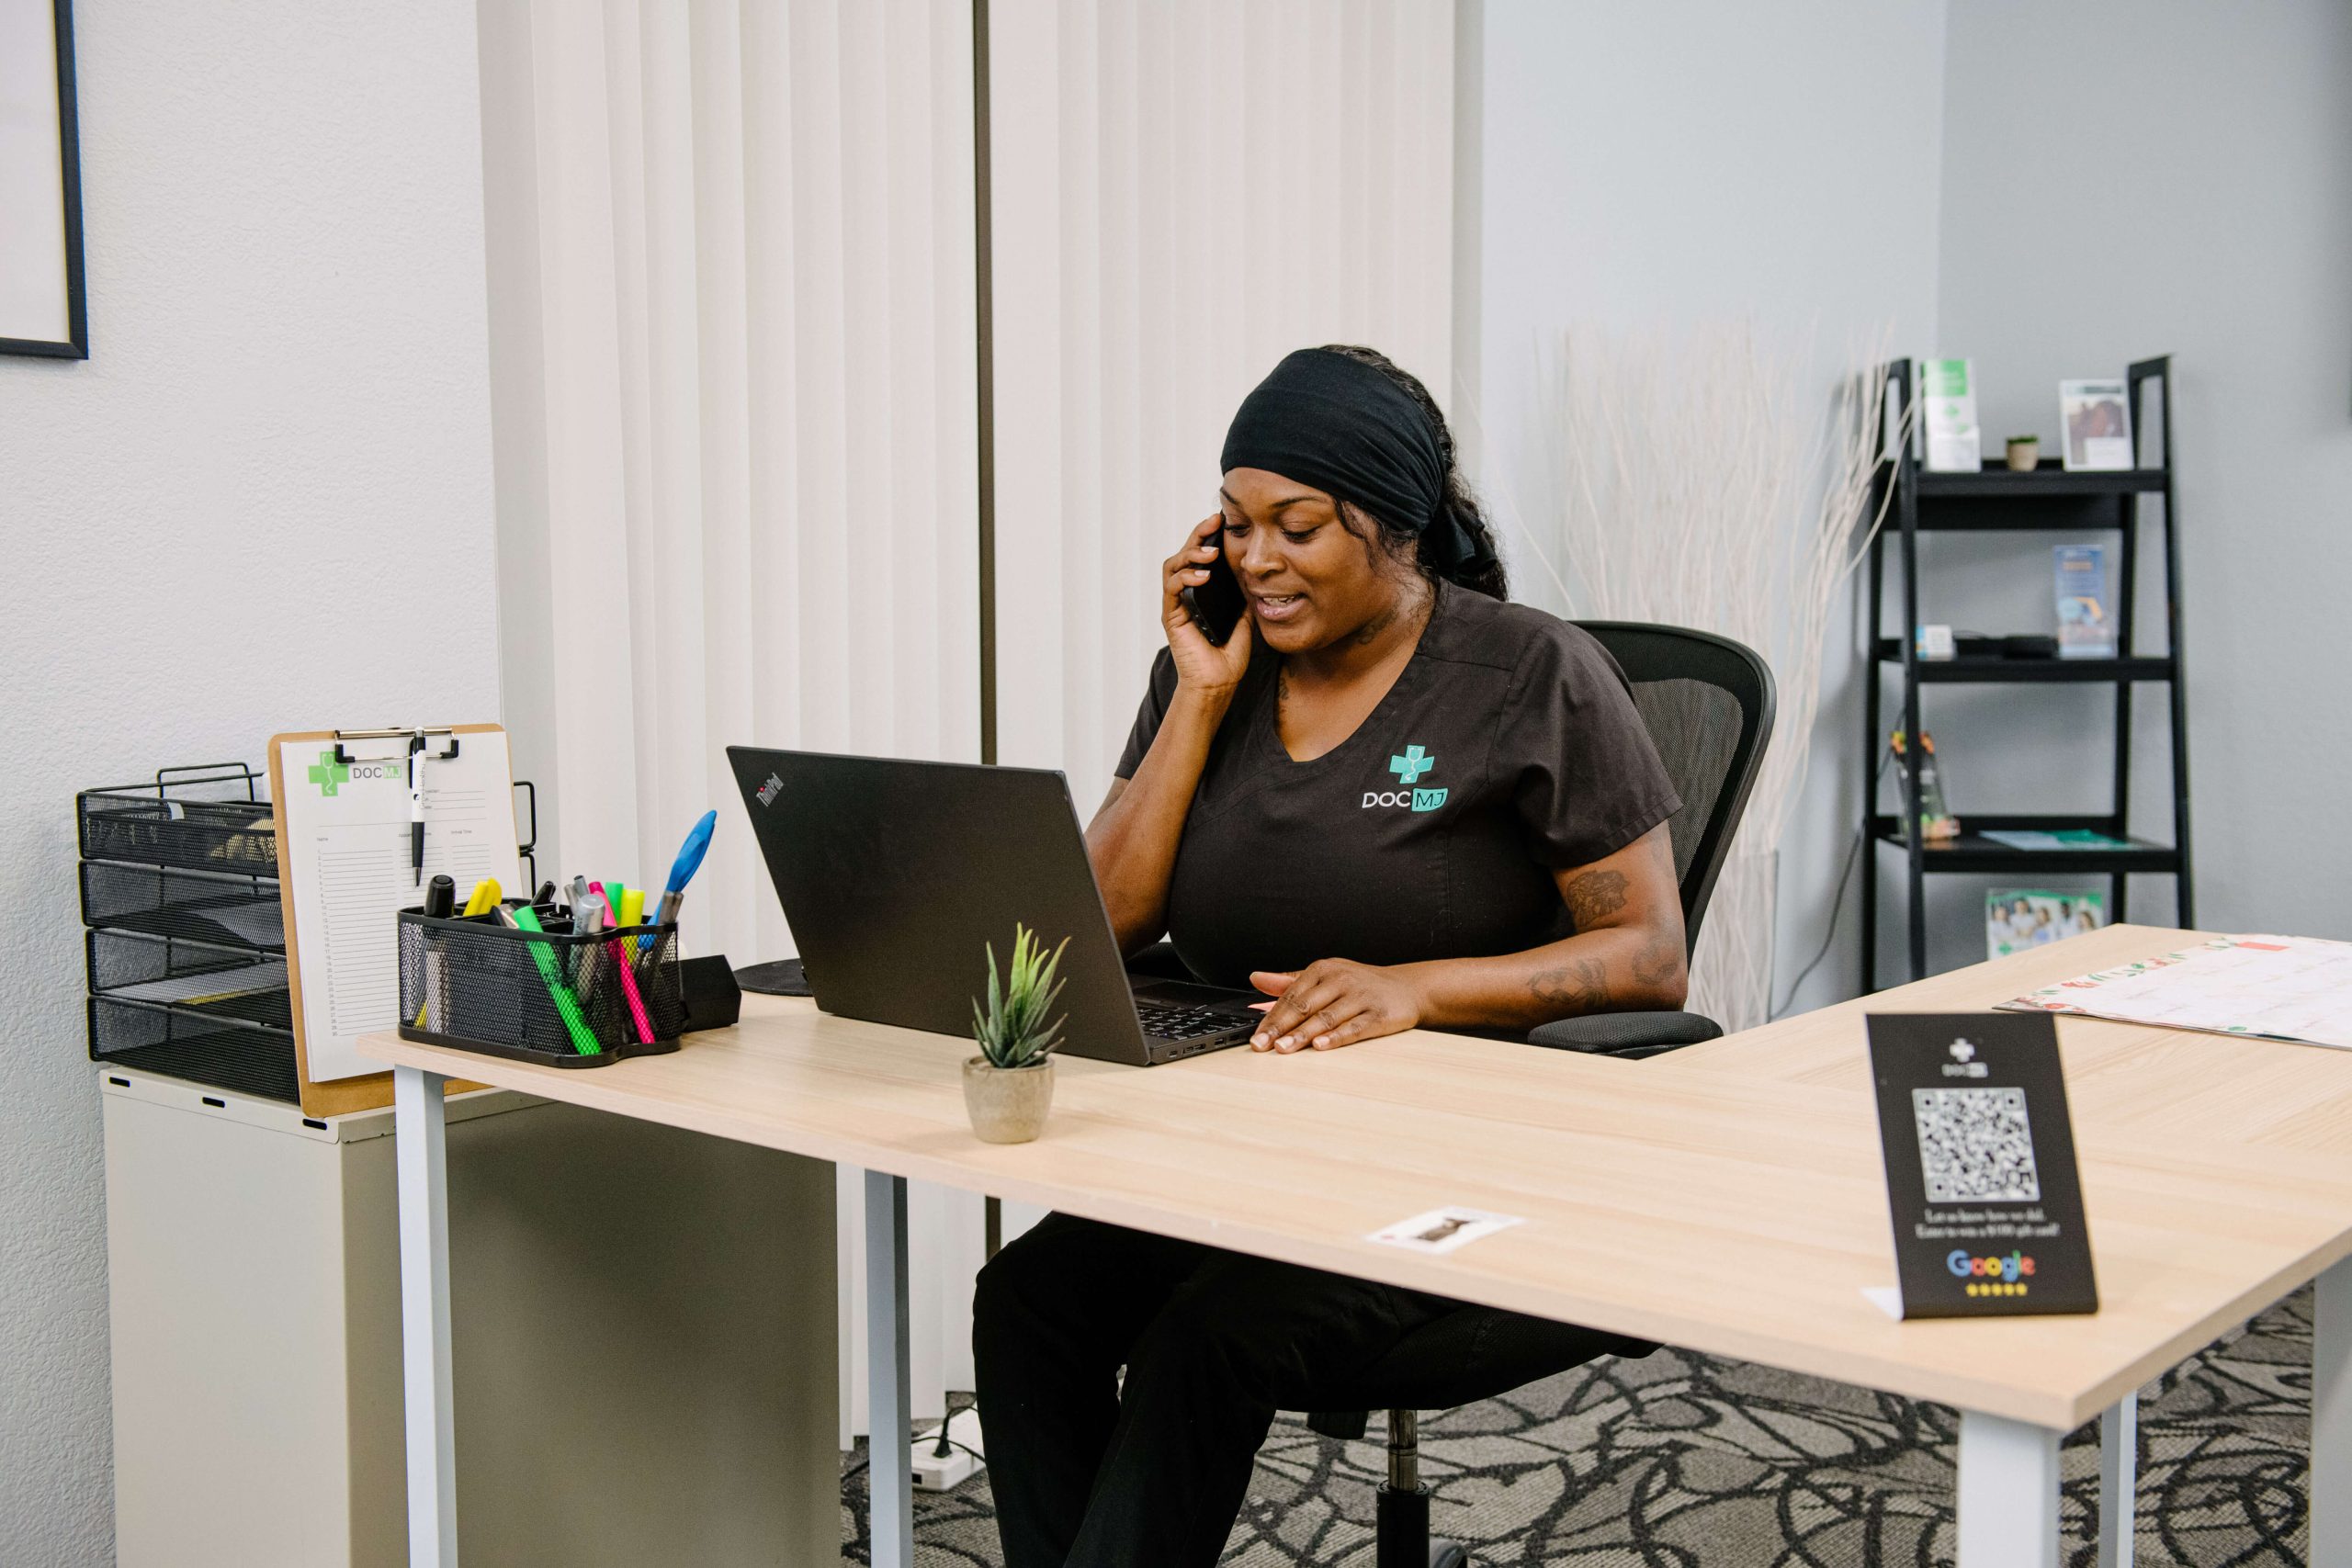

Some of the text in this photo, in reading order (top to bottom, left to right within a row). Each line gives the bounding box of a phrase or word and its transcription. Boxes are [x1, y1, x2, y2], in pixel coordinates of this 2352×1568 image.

[353, 766, 401, 779] DOCMJ
[1362, 790, 1446, 809] DOCMJ
[1947, 1249, 2036, 1282] Google
